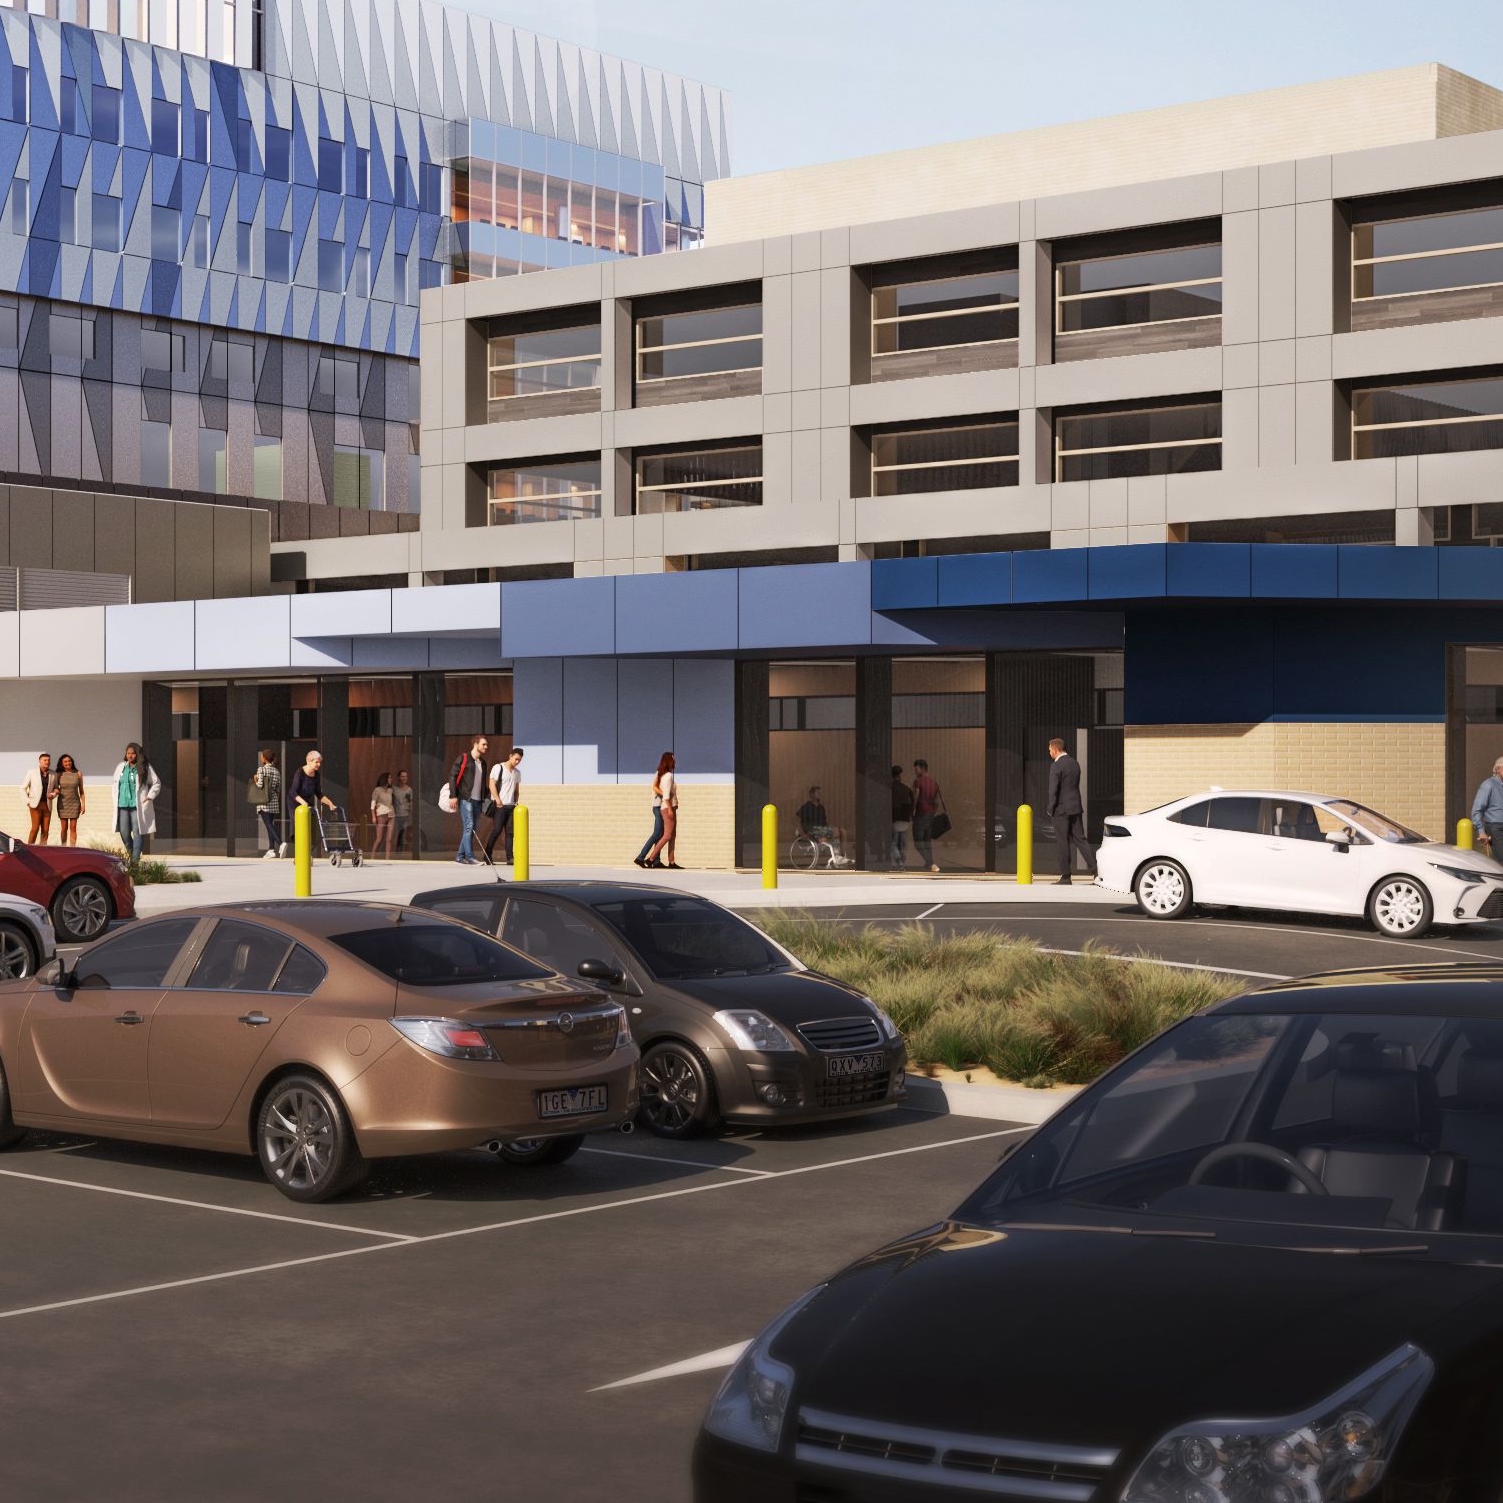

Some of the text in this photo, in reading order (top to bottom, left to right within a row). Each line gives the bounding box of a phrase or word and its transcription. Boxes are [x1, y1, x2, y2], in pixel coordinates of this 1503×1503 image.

[831, 1058, 854, 1072] QXV
[862, 1055, 882, 1069] 573
[543, 1089, 605, 1111] 1GE 7FL
